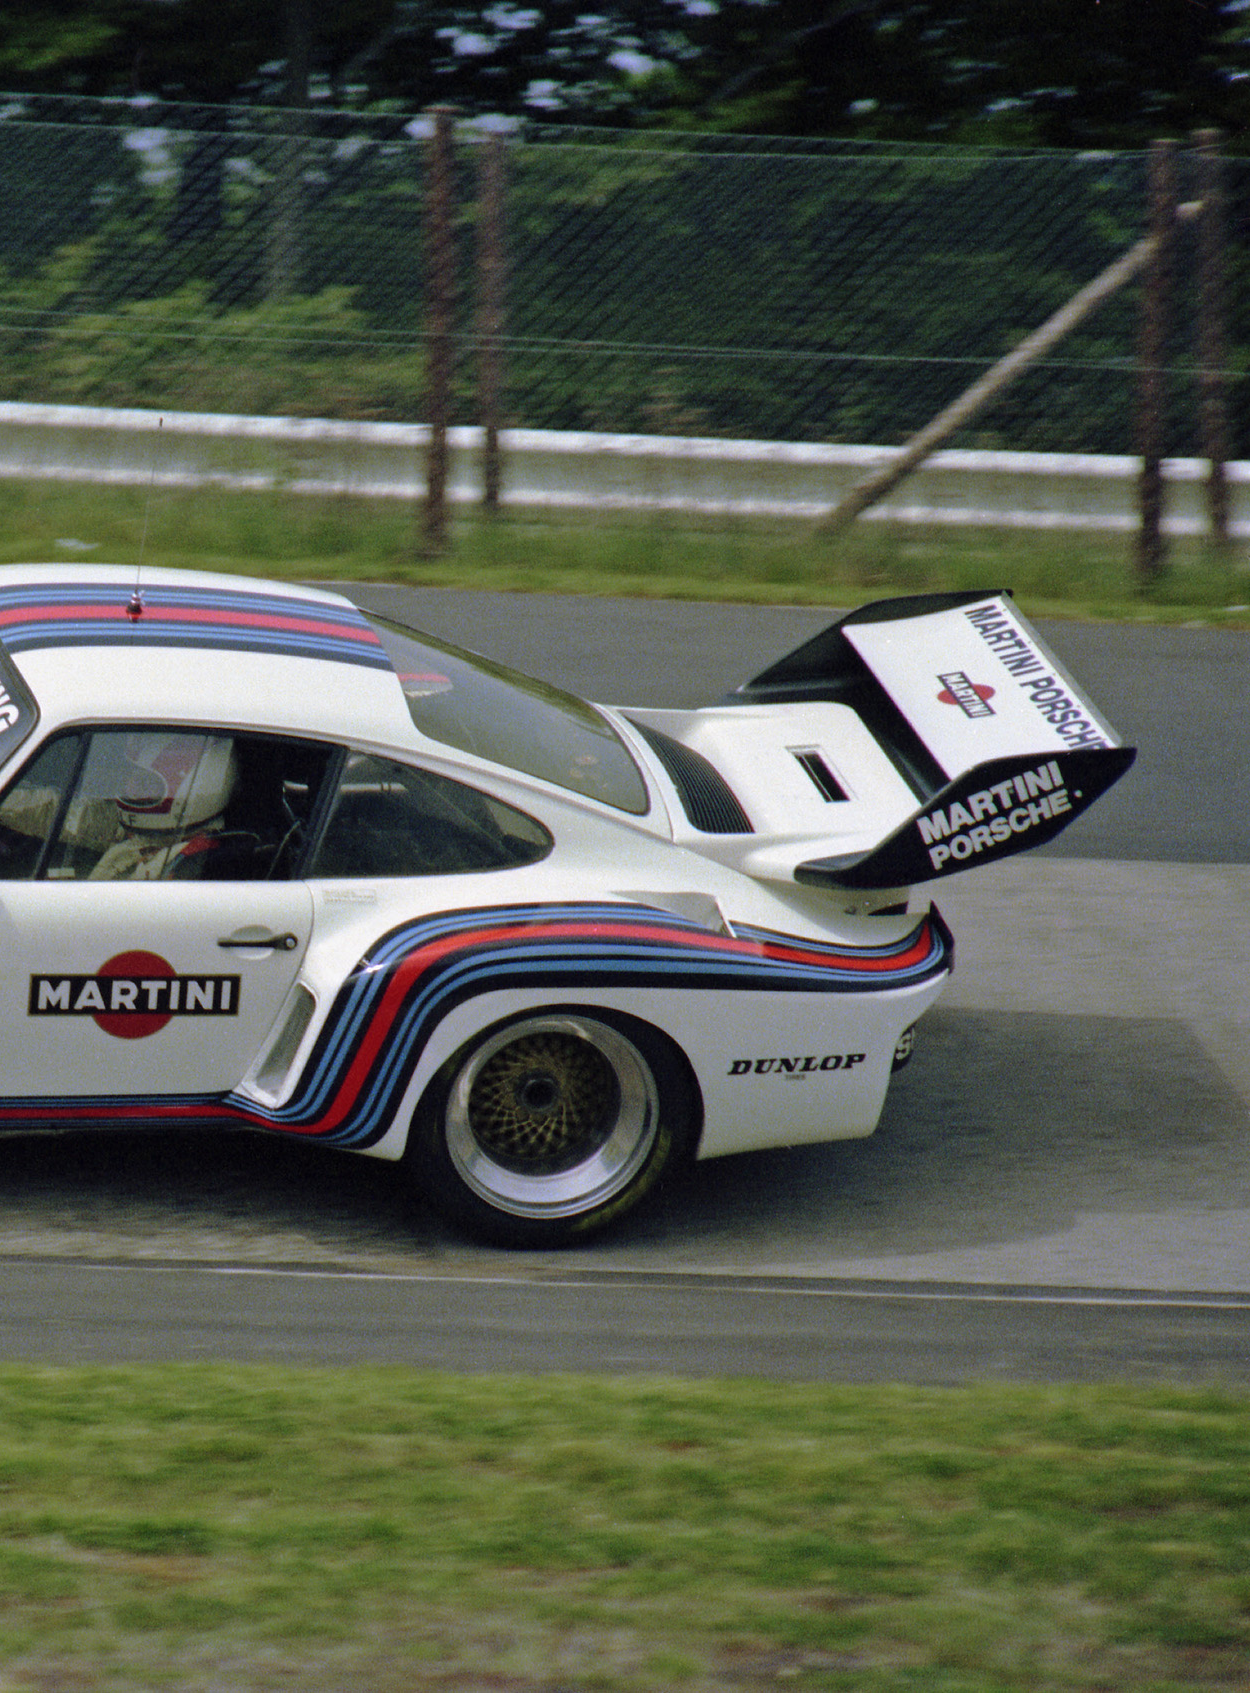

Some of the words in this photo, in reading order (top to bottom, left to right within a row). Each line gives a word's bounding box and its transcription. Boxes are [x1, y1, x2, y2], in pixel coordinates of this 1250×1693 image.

[964, 604, 1045, 678] MARTINI
[916, 761, 1064, 845] MARTINI
[928, 789, 1073, 870] PORSCHE
[37, 979, 232, 1011] MARTINI
[727, 1053, 867, 1075] DUNLOP
